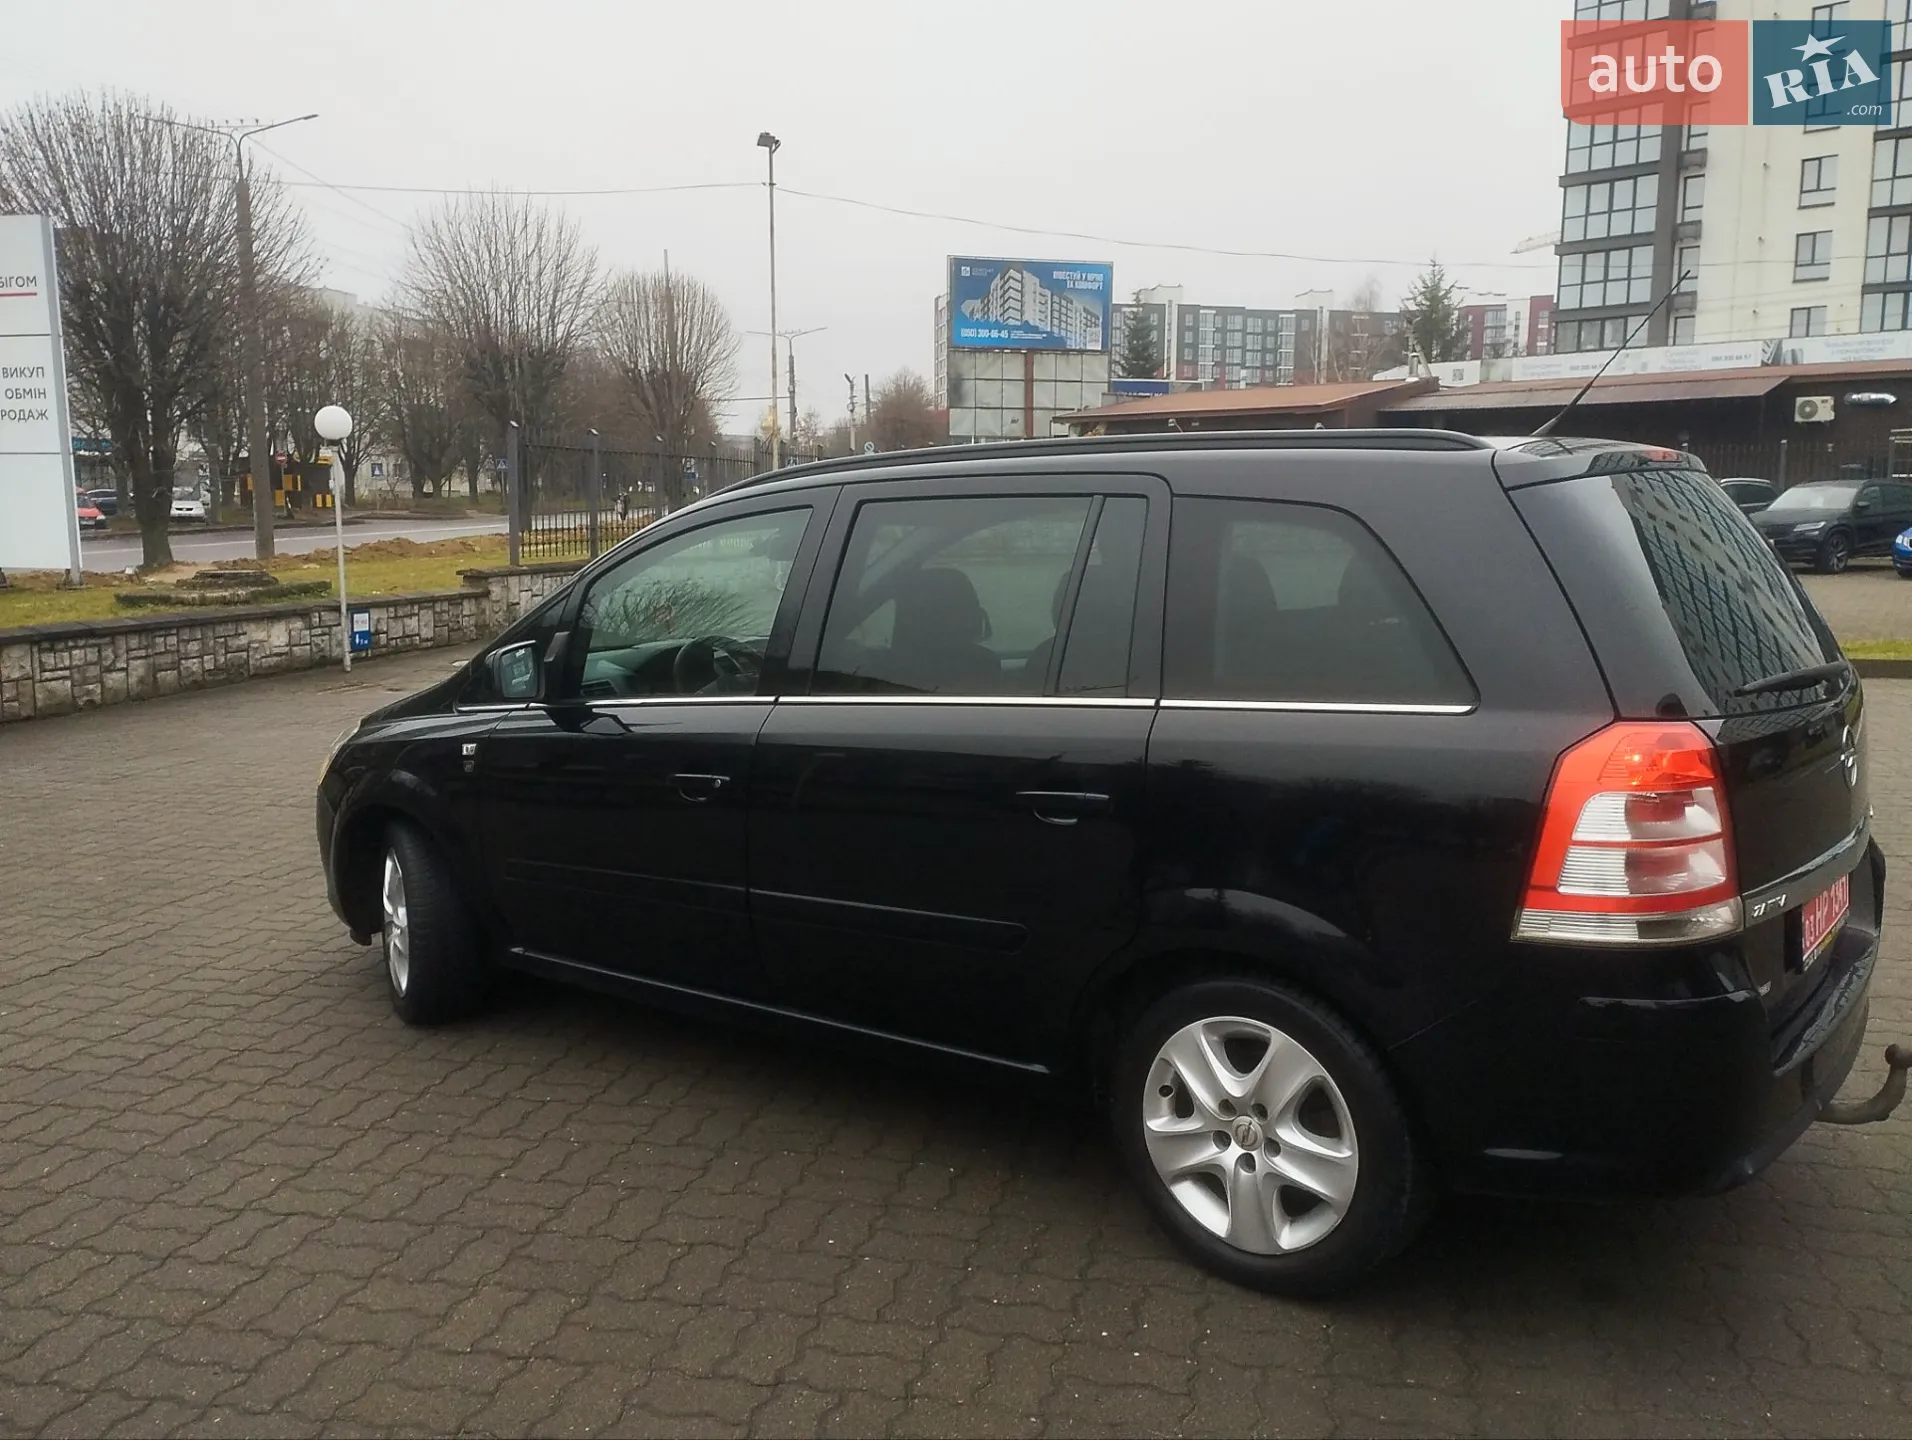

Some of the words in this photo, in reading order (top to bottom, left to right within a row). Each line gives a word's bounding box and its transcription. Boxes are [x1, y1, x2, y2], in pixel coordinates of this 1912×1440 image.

[2, 366, 45, 379] ВИКУП
[4, 387, 47, 400] ОБМІН
[0, 408, 49, 423] РОДАЖ
